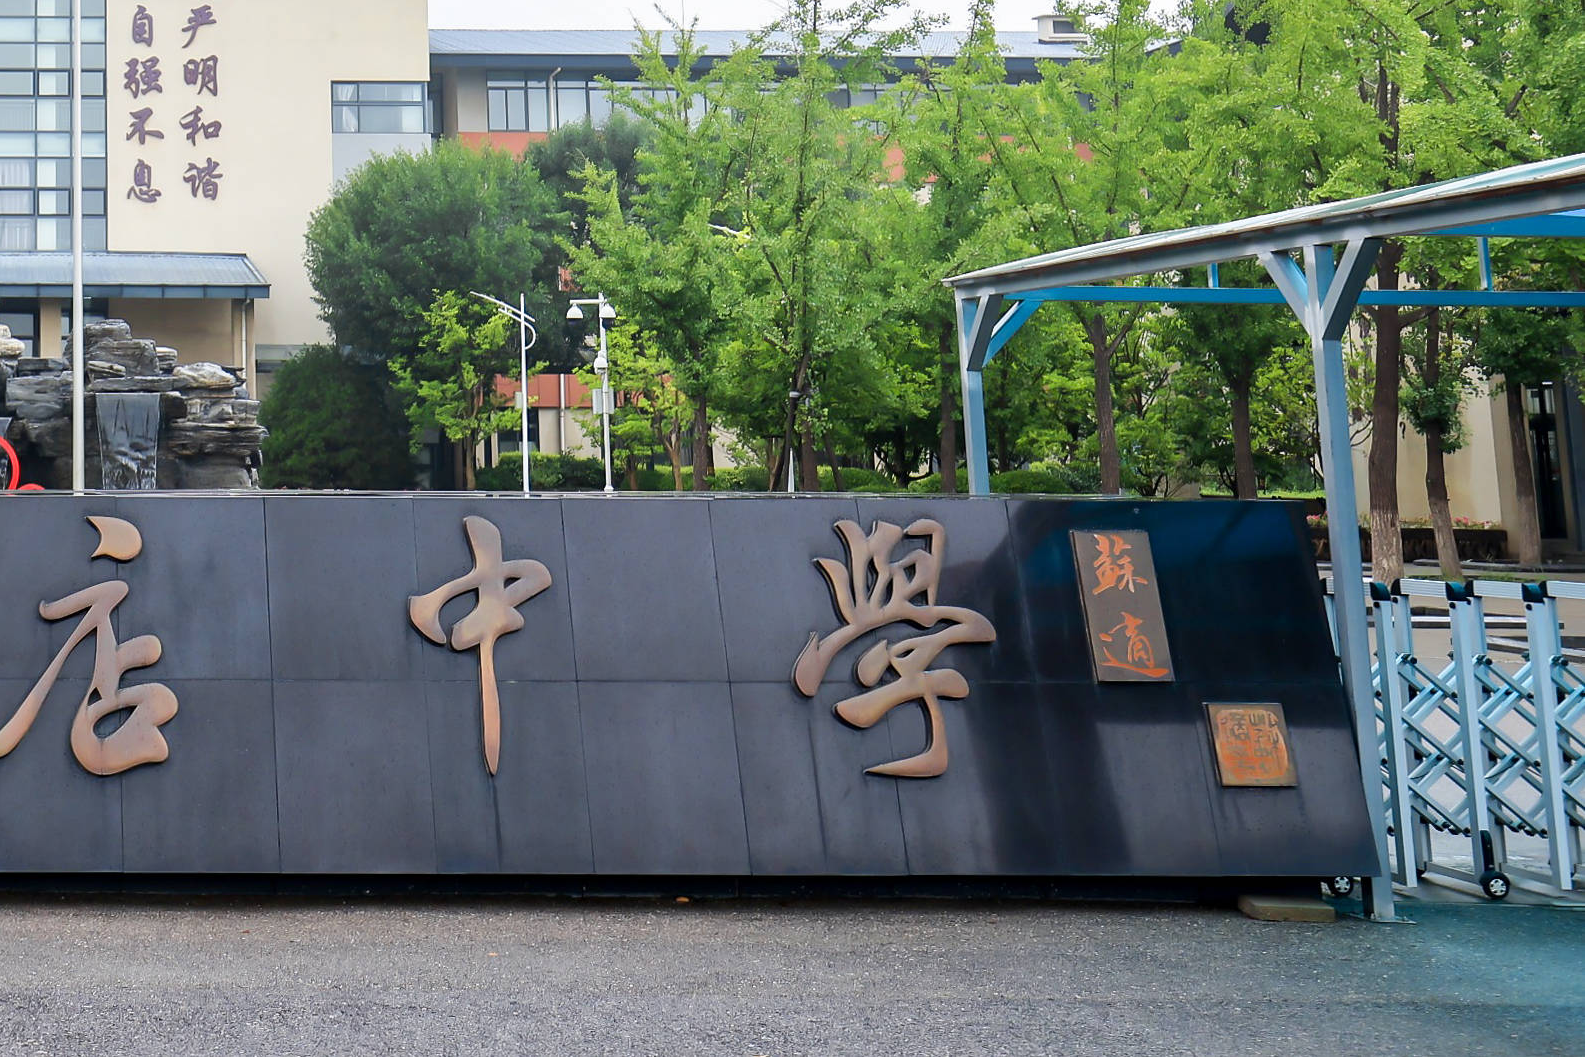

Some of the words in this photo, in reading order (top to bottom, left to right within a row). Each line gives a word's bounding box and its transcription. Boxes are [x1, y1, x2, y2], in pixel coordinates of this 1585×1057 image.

[123, 4, 165, 205] 自强不息
[179, 3, 224, 201] 严明和谐
